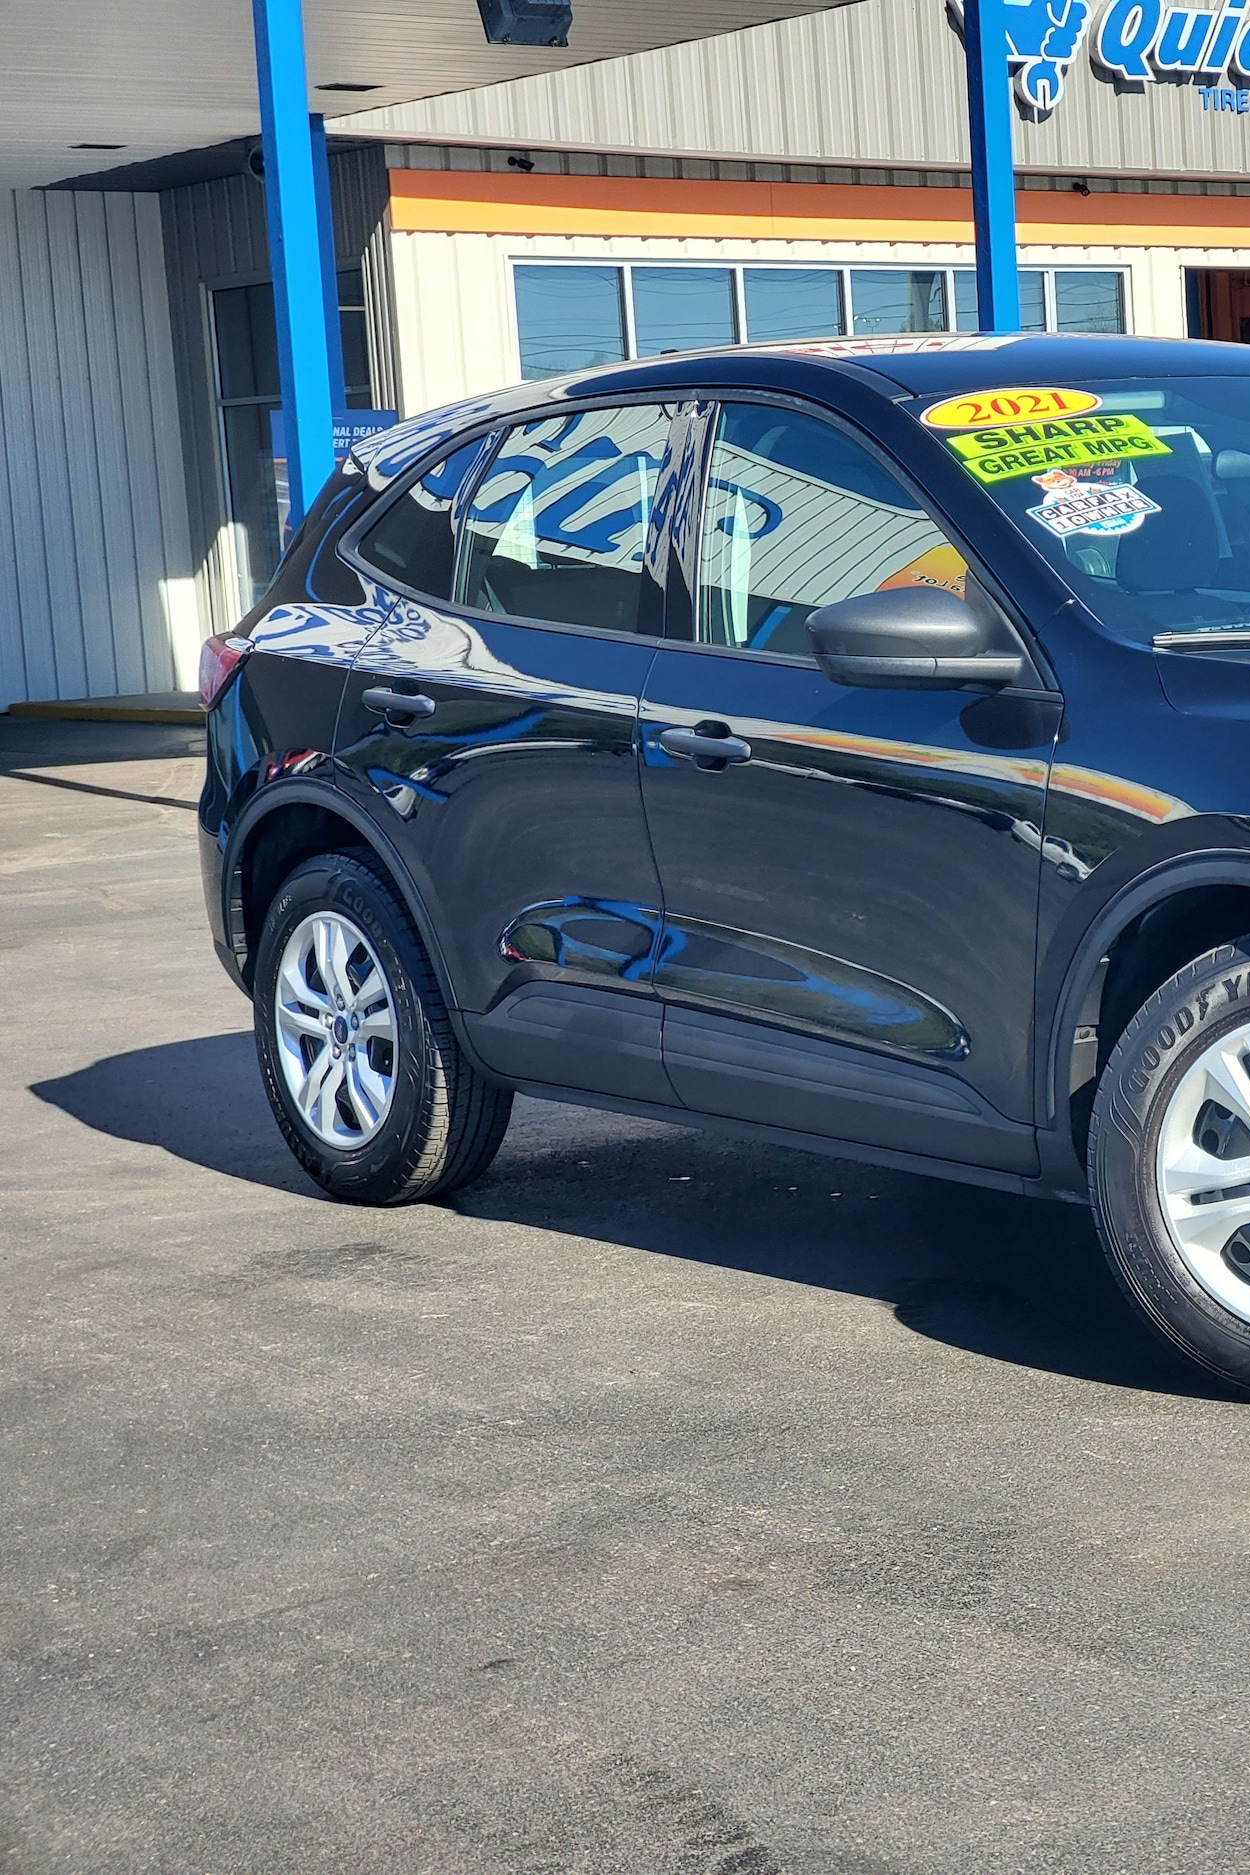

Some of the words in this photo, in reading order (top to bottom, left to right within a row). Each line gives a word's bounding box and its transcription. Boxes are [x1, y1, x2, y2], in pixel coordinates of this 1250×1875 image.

[1199, 88, 1249, 112] TIRE
[956, 392, 1070, 423] 2021
[973, 417, 1125, 450] SHARP
[978, 444, 1078, 473] GREAT
[1087, 436, 1153, 457] MPG
[1102, 467, 1114, 475] PM
[1038, 491, 1134, 519] CARFAX
[1067, 499, 1151, 526] OWNER
